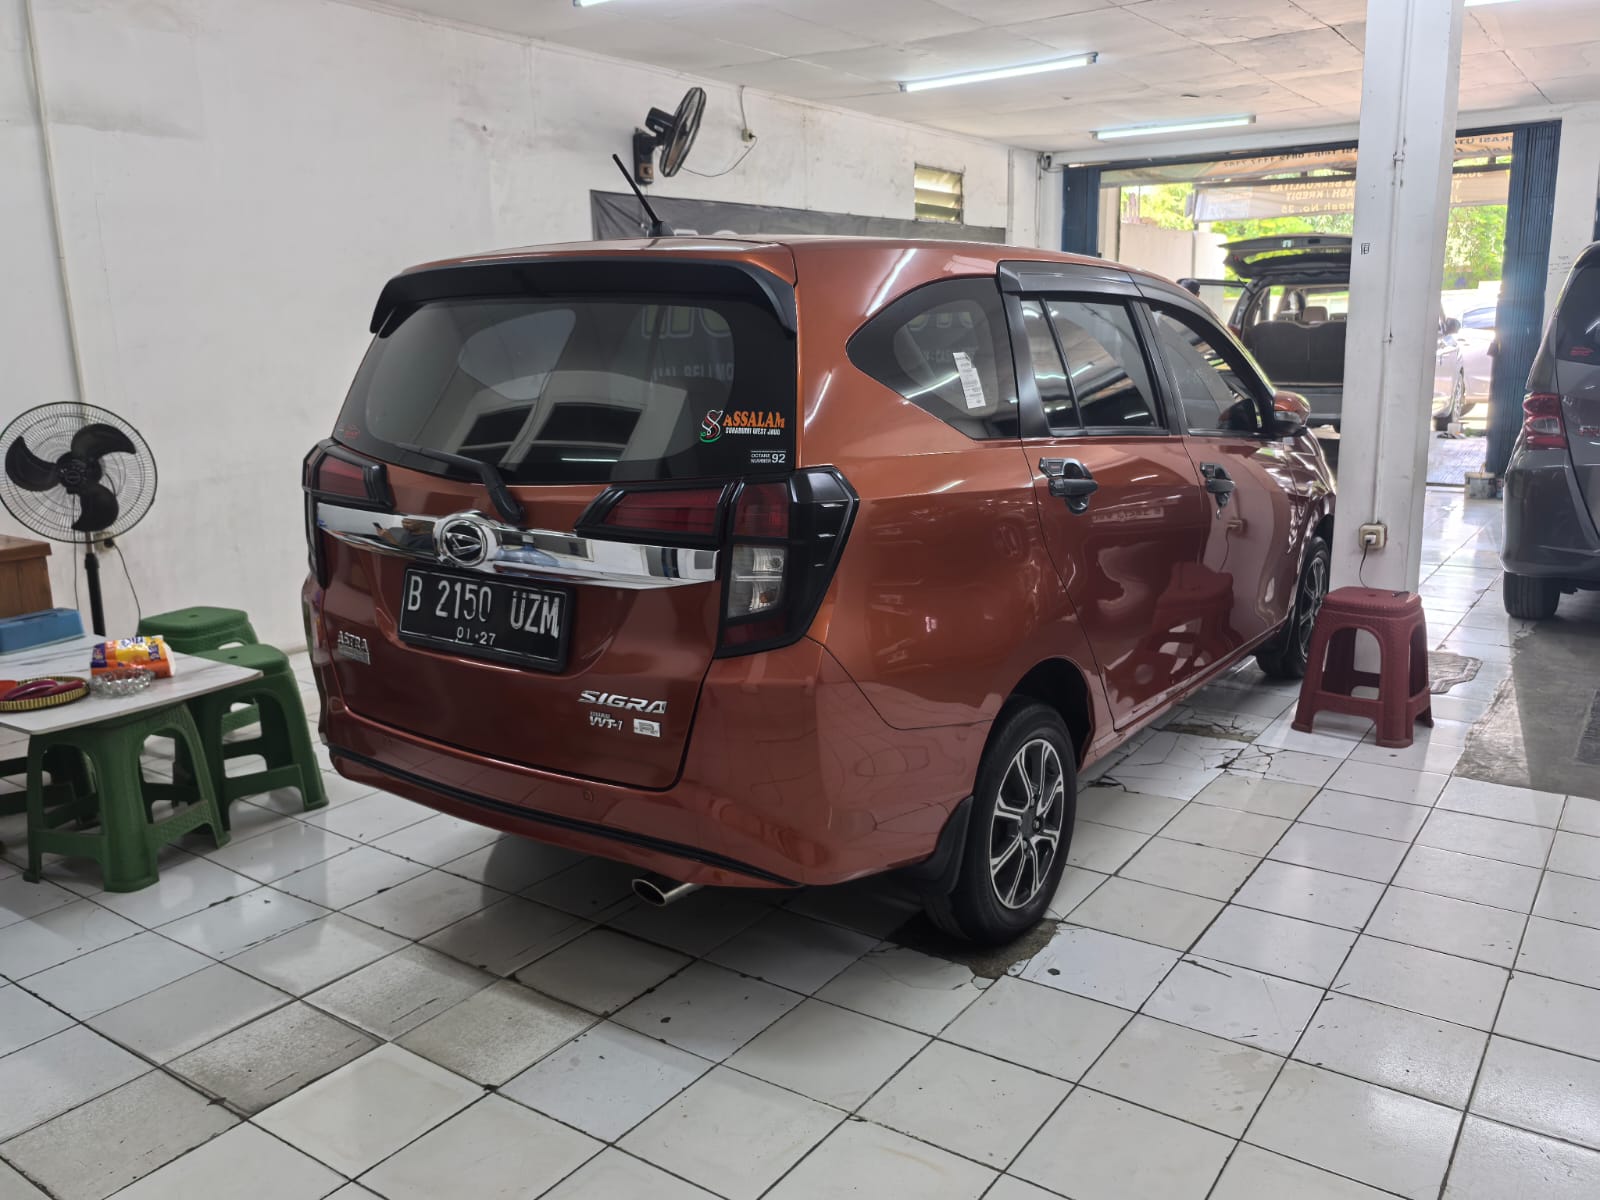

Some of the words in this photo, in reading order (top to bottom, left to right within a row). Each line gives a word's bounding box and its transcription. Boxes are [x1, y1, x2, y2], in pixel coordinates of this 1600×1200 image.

[771, 453, 786, 464] 92
[407, 575, 423, 611] B
[435, 580, 492, 622] 2150
[510, 591, 561, 640] UZM
[578, 690, 667, 714] SIGRA
